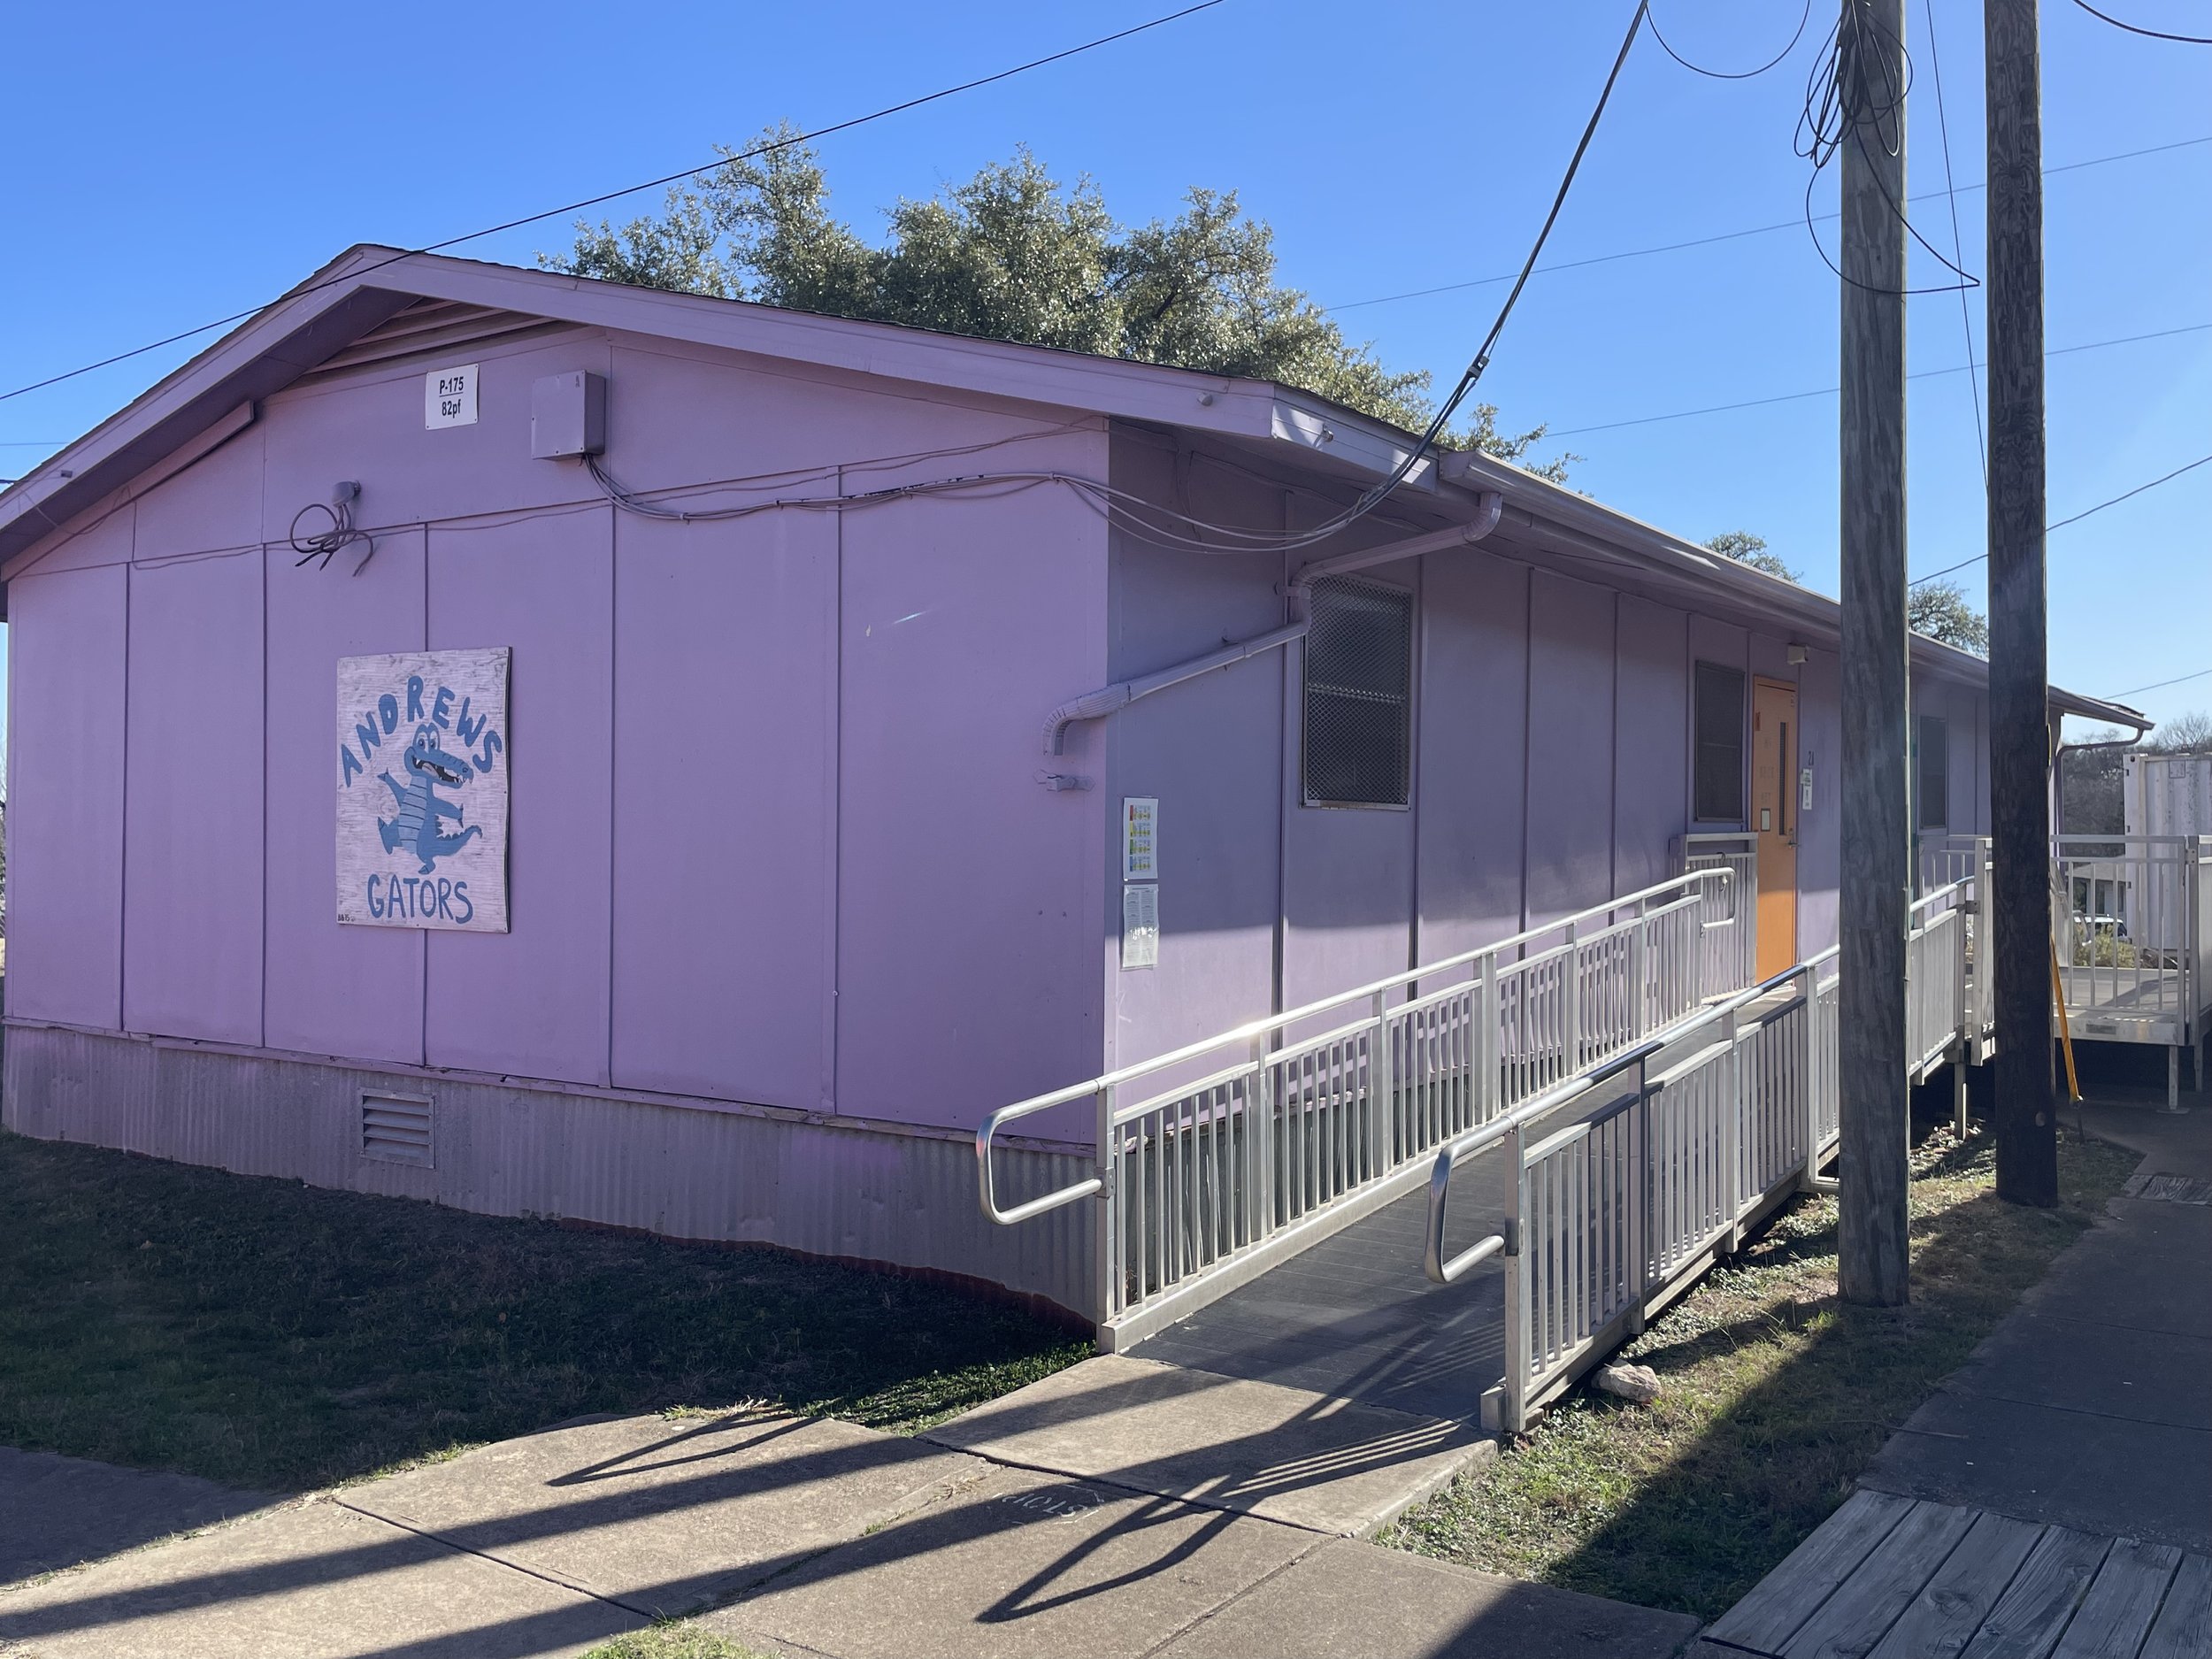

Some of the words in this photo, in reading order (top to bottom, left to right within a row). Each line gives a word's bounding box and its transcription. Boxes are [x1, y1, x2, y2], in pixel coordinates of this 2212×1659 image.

[439, 376, 464, 395] P-175
[442, 398, 461, 419] 82pf
[341, 675, 503, 787] ANDREWS
[367, 873, 473, 925] GATORS
